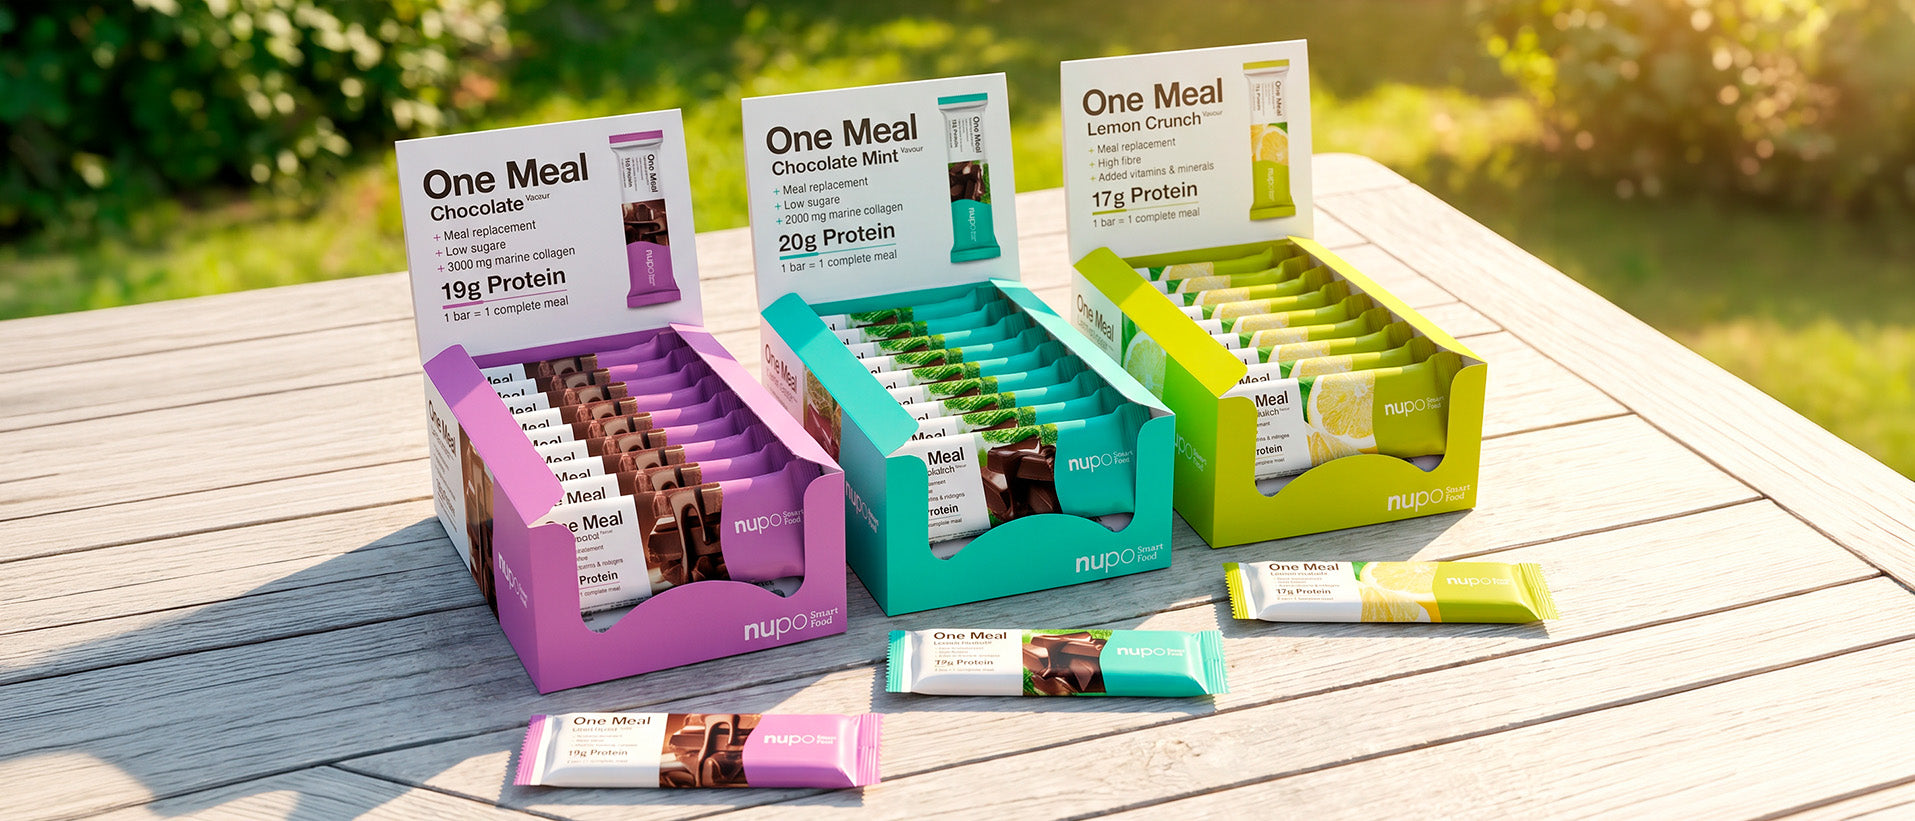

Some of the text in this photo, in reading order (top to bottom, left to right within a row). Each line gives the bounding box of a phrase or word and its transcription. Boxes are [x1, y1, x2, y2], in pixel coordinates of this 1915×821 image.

[1083, 78, 1223, 116] One Meal
[766, 126, 832, 154] One
[842, 113, 918, 146] Meal
[1088, 120, 1140, 136] Lemon
[1146, 112, 1201, 130] Crunch
[1097, 143, 1119, 154] Meal
[1121, 138, 1176, 154] replacement
[772, 154, 858, 176] Chocolate
[862, 148, 898, 166] Mint
[1098, 158, 1120, 170] High
[1121, 156, 1142, 166] fibre
[1098, 172, 1128, 182] Added
[1130, 166, 1166, 178] vitamins
[1169, 165, 1176, 175] &
[1178, 161, 1214, 174] minerals
[424, 168, 496, 200] One
[506, 152, 588, 190] Meal
[783, 184, 806, 194] Meal
[809, 176, 868, 194] replacement
[784, 199, 804, 210] Low
[808, 196, 840, 208] sugare
[1092, 182, 1198, 208] 17g Protein
[430, 197, 524, 221] Chocolate
[785, 214, 809, 224] 2000
[811, 212, 826, 223] mg
[829, 206, 862, 218] marine
[864, 202, 904, 216] collagen
[1093, 219, 1098, 228] 1
[1100, 216, 1116, 227] bar
[1128, 214, 1132, 223] 1
[1135, 210, 1176, 224] complete
[1178, 208, 1200, 218] meal
[444, 228, 470, 241] Meal
[472, 220, 536, 238] replacement
[779, 222, 895, 252] 20g Protein
[446, 242, 468, 256] Low
[471, 240, 506, 255] sugare
[448, 258, 474, 272] 3000
[476, 258, 493, 270] mg
[494, 252, 530, 266] marine
[532, 246, 576, 263] collagen
[782, 264, 786, 272] 1
[790, 260, 806, 272] bar
[819, 259, 824, 268] 1
[828, 254, 872, 268] complete
[874, 250, 897, 261] meal
[442, 268, 566, 301] 19g Protein
[444, 313, 450, 322] 1
[454, 308, 471, 322] bar
[485, 307, 490, 317] 1
[494, 299, 541, 317] complete
[544, 296, 568, 310] meal
[1077, 294, 1094, 322] One
[1095, 310, 1114, 342] Meal
[765, 344, 780, 374] One
[781, 360, 798, 394] Meal
[1255, 390, 1288, 407] Meal
[1384, 399, 1425, 416] nupo
[442, 419, 456, 458] Meal
[928, 447, 964, 465] Meal
[1256, 444, 1282, 456] rotein
[1068, 454, 1112, 472] nupo
[567, 487, 606, 504] Meal
[846, 480, 868, 520] nupo
[1388, 484, 1470, 512] nupo Smart
[1446, 492, 1464, 502] Food
[582, 510, 624, 530] Meal
[928, 504, 958, 516] rotein
[734, 513, 782, 534] nupo
[784, 516, 802, 526] Food
[1076, 544, 1164, 573] nupo Smart
[1138, 552, 1157, 562] Food
[498, 552, 520, 595] nupo
[1269, 563, 1340, 572] One Meal
[579, 571, 618, 586] Protein
[1446, 577, 1492, 587] nupo
[1276, 588, 1332, 596] 17g Protein
[744, 607, 838, 640] nupo Smart
[810, 616, 832, 628] Food
[934, 632, 1007, 640] One Meal
[1117, 648, 1166, 658] nupo
[574, 716, 651, 726] One Meal
[764, 734, 815, 746] nupo
